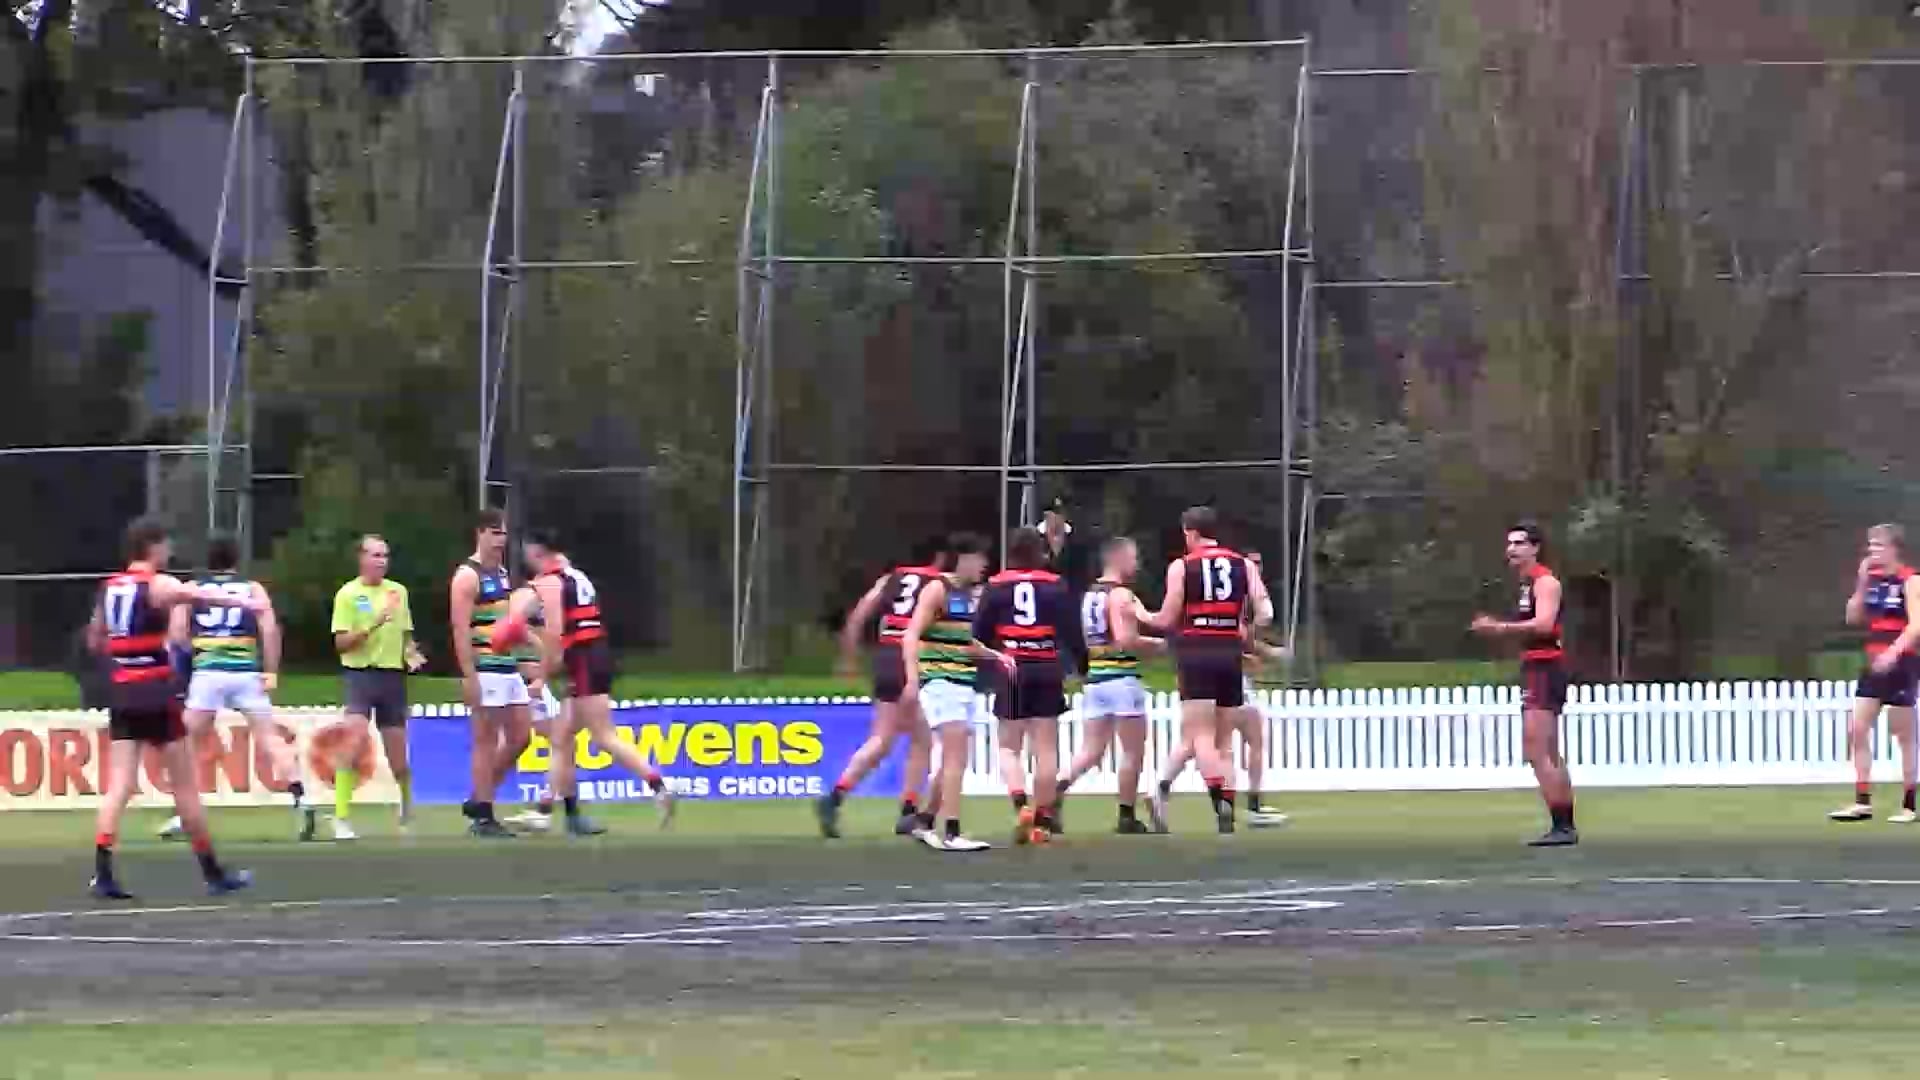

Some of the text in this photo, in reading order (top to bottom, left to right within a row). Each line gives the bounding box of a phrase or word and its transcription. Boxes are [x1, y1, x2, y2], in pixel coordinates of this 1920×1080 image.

[893, 574, 921, 615] 3
[1202, 557, 1232, 601] 13
[1013, 582, 1037, 625] 9
[719, 776, 823, 797] CHOICE
